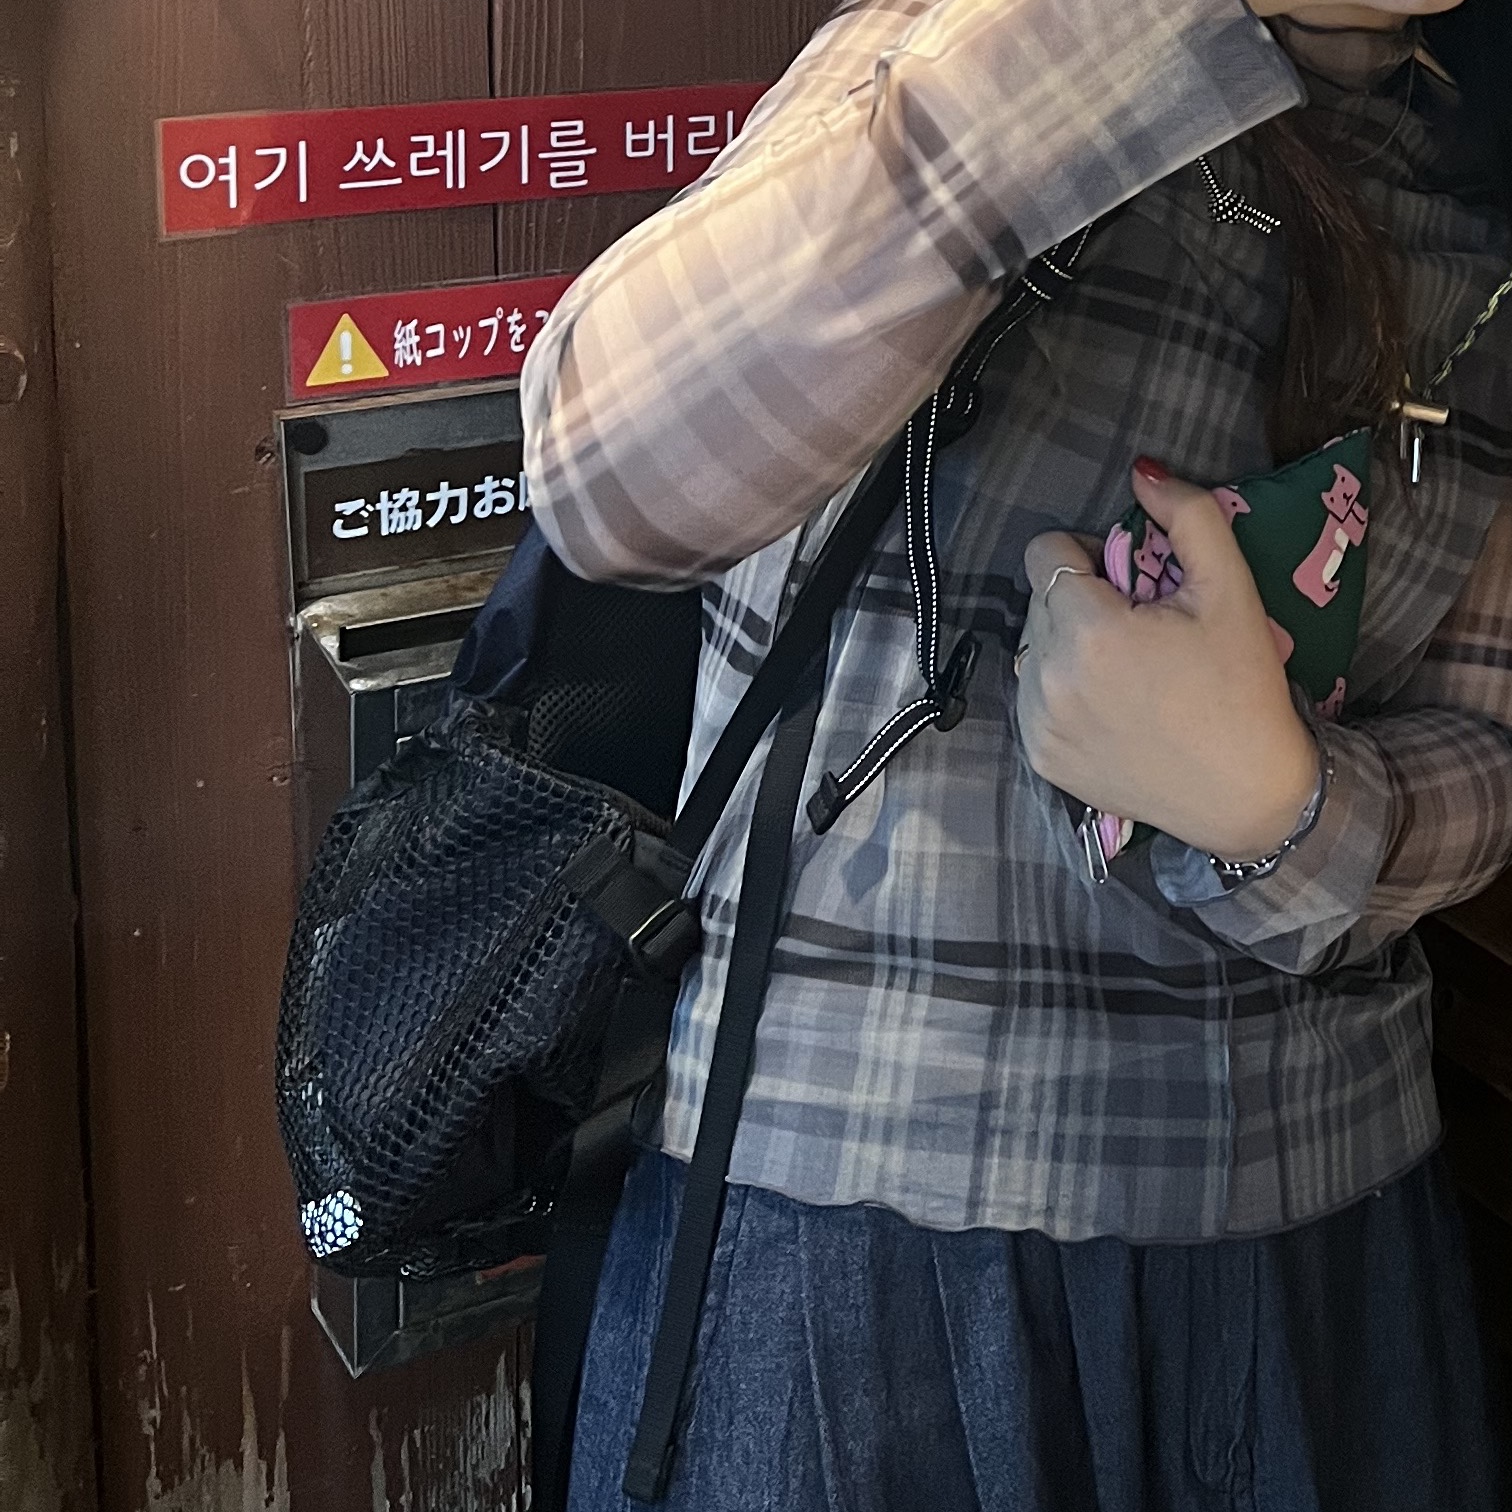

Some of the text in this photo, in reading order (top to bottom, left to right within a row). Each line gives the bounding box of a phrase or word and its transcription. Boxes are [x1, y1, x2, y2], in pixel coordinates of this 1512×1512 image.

[179, 140, 307, 209] 여기
[339, 119, 598, 190] 쓰레기를
[332, 471, 530, 539] ご協力お
